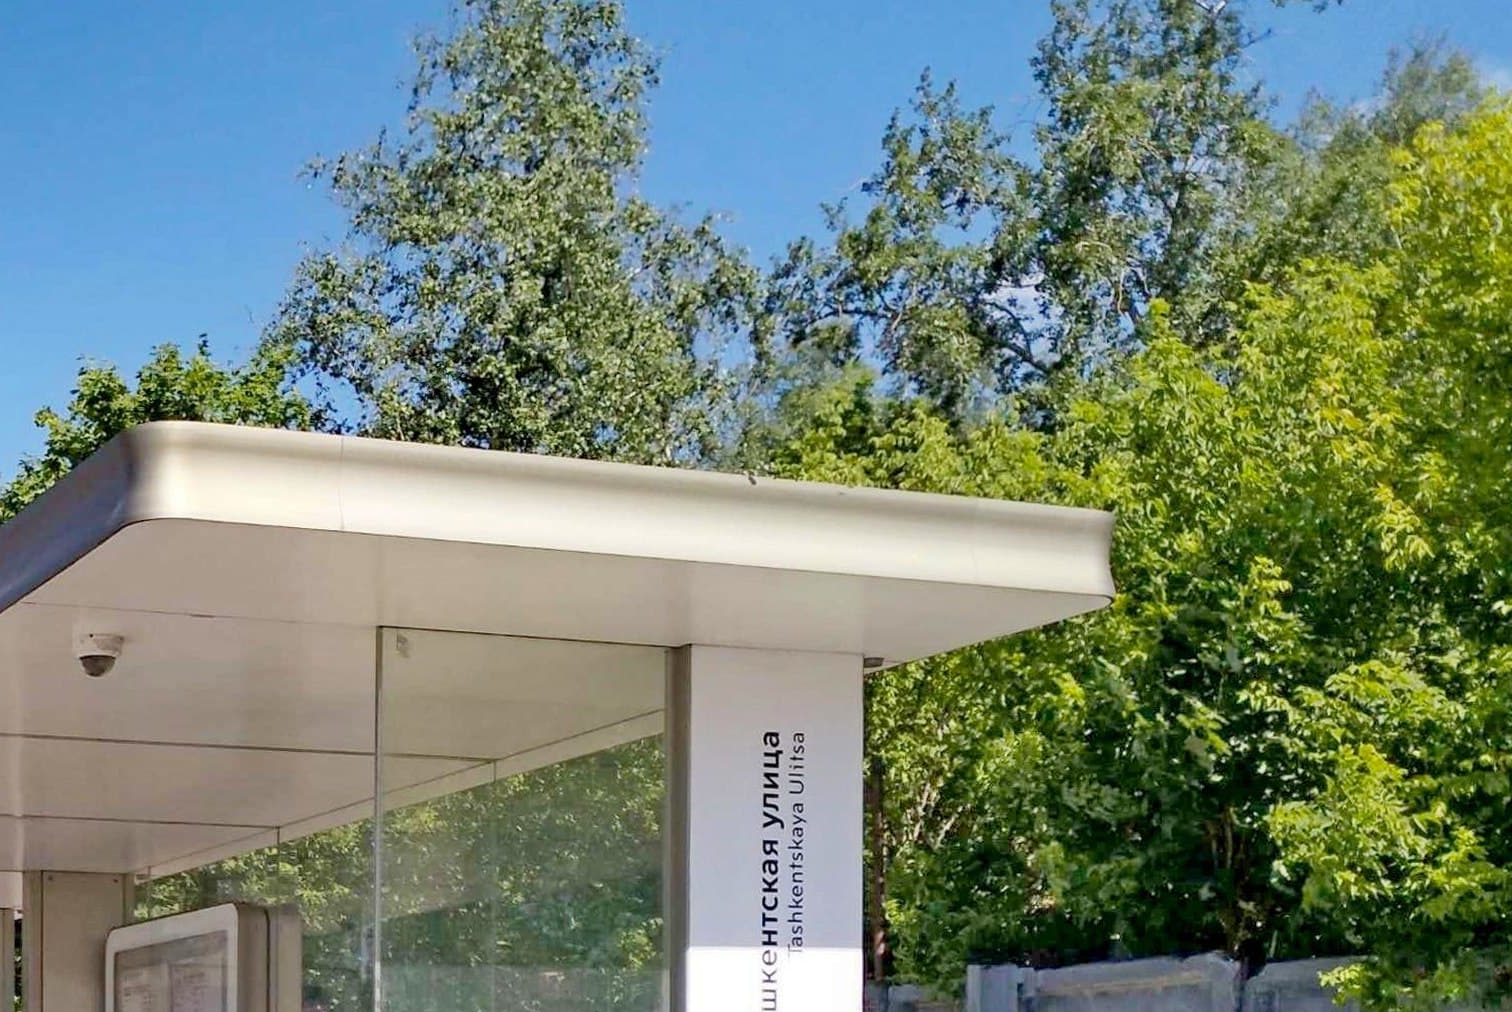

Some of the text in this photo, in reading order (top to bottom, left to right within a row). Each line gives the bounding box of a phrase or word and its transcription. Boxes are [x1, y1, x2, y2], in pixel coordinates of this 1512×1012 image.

[762, 730, 784, 829] улица
[788, 732, 807, 957] Tashkentskaya Ulitsa
